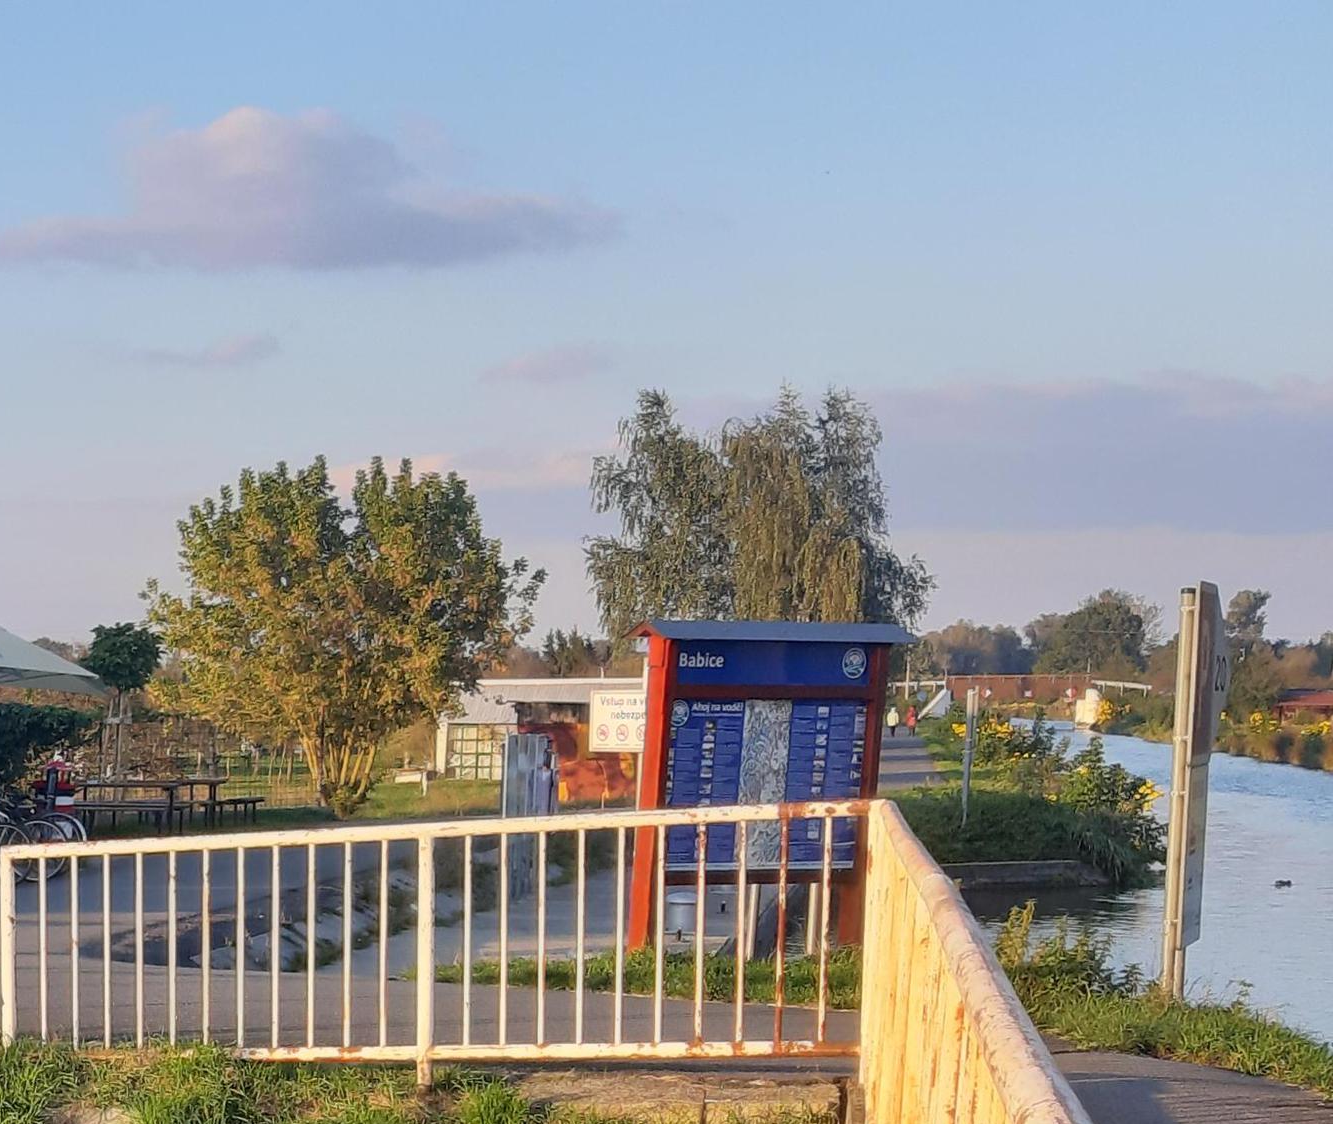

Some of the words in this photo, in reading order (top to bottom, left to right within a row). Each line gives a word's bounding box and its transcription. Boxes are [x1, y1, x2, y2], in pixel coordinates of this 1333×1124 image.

[678, 652, 725, 668] Babice
[600, 696, 624, 708] Vstup
[626, 696, 638, 706] na
[691, 702, 711, 712] Ahoj
[711, 704, 721, 712] na
